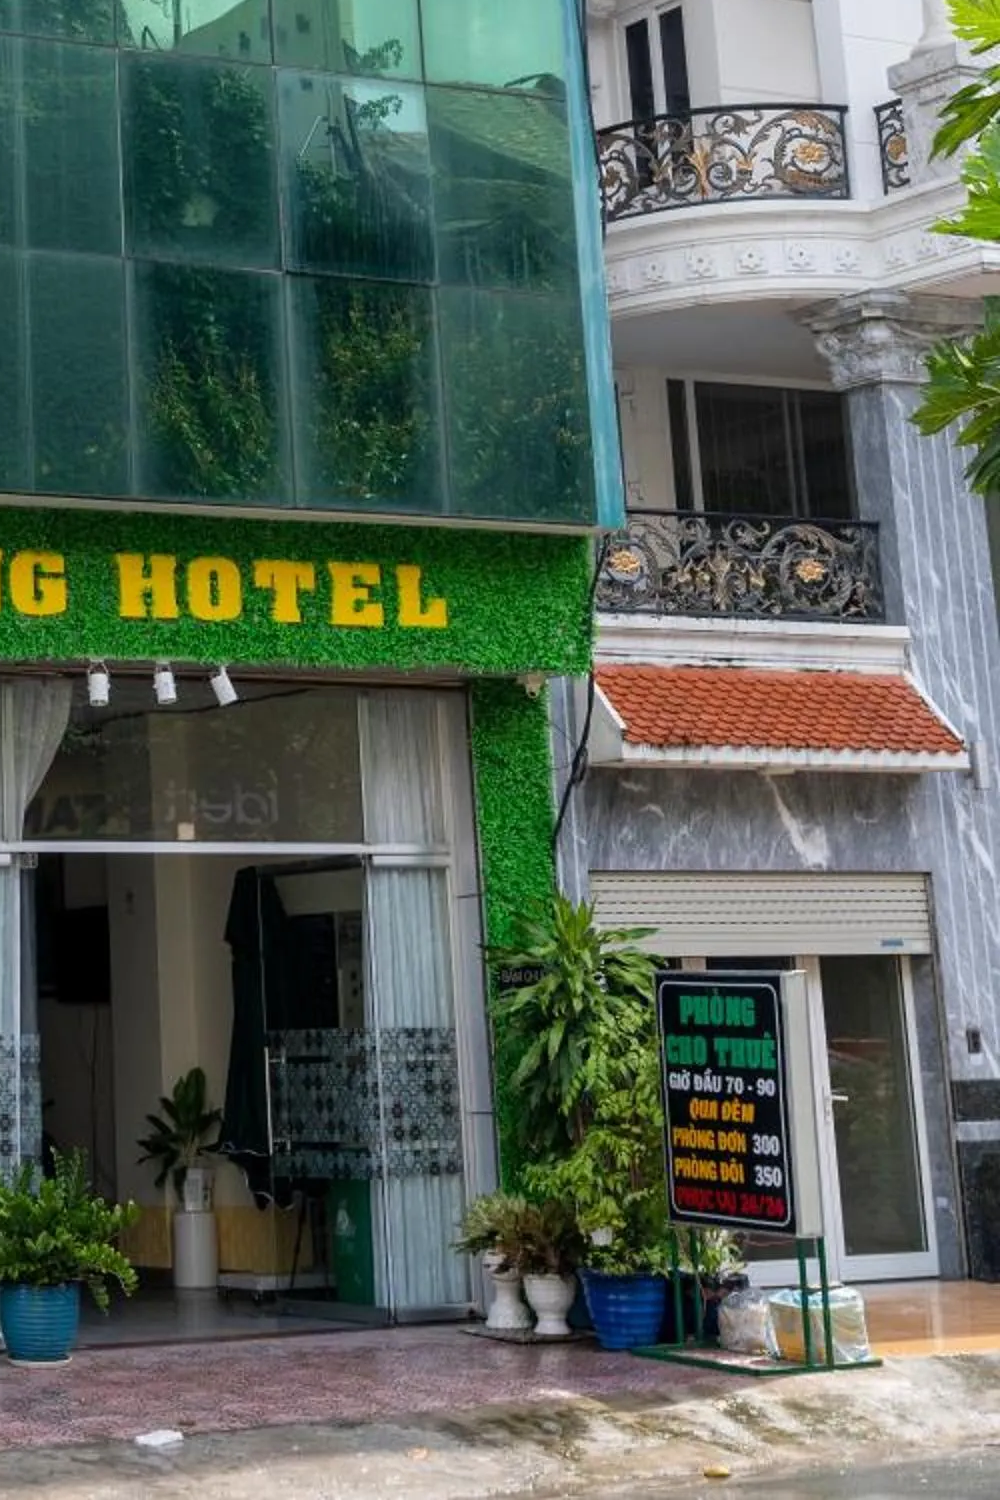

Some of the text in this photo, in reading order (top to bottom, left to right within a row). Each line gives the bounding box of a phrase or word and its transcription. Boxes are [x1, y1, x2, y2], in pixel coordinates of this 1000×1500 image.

[116, 553, 448, 628] HOTEL
[666, 1031, 777, 1069] CHO THUÊ
[669, 1069, 691, 1091] GIỜ
[725, 1075, 744, 1094] 70
[756, 1078, 776, 1097] 90
[689, 1097, 718, 1121] QUA
[672, 1122, 715, 1150] PHÒNG
[752, 1133, 780, 1156] 300
[674, 1153, 717, 1181] PHÒNG
[754, 1165, 782, 1188] 350
